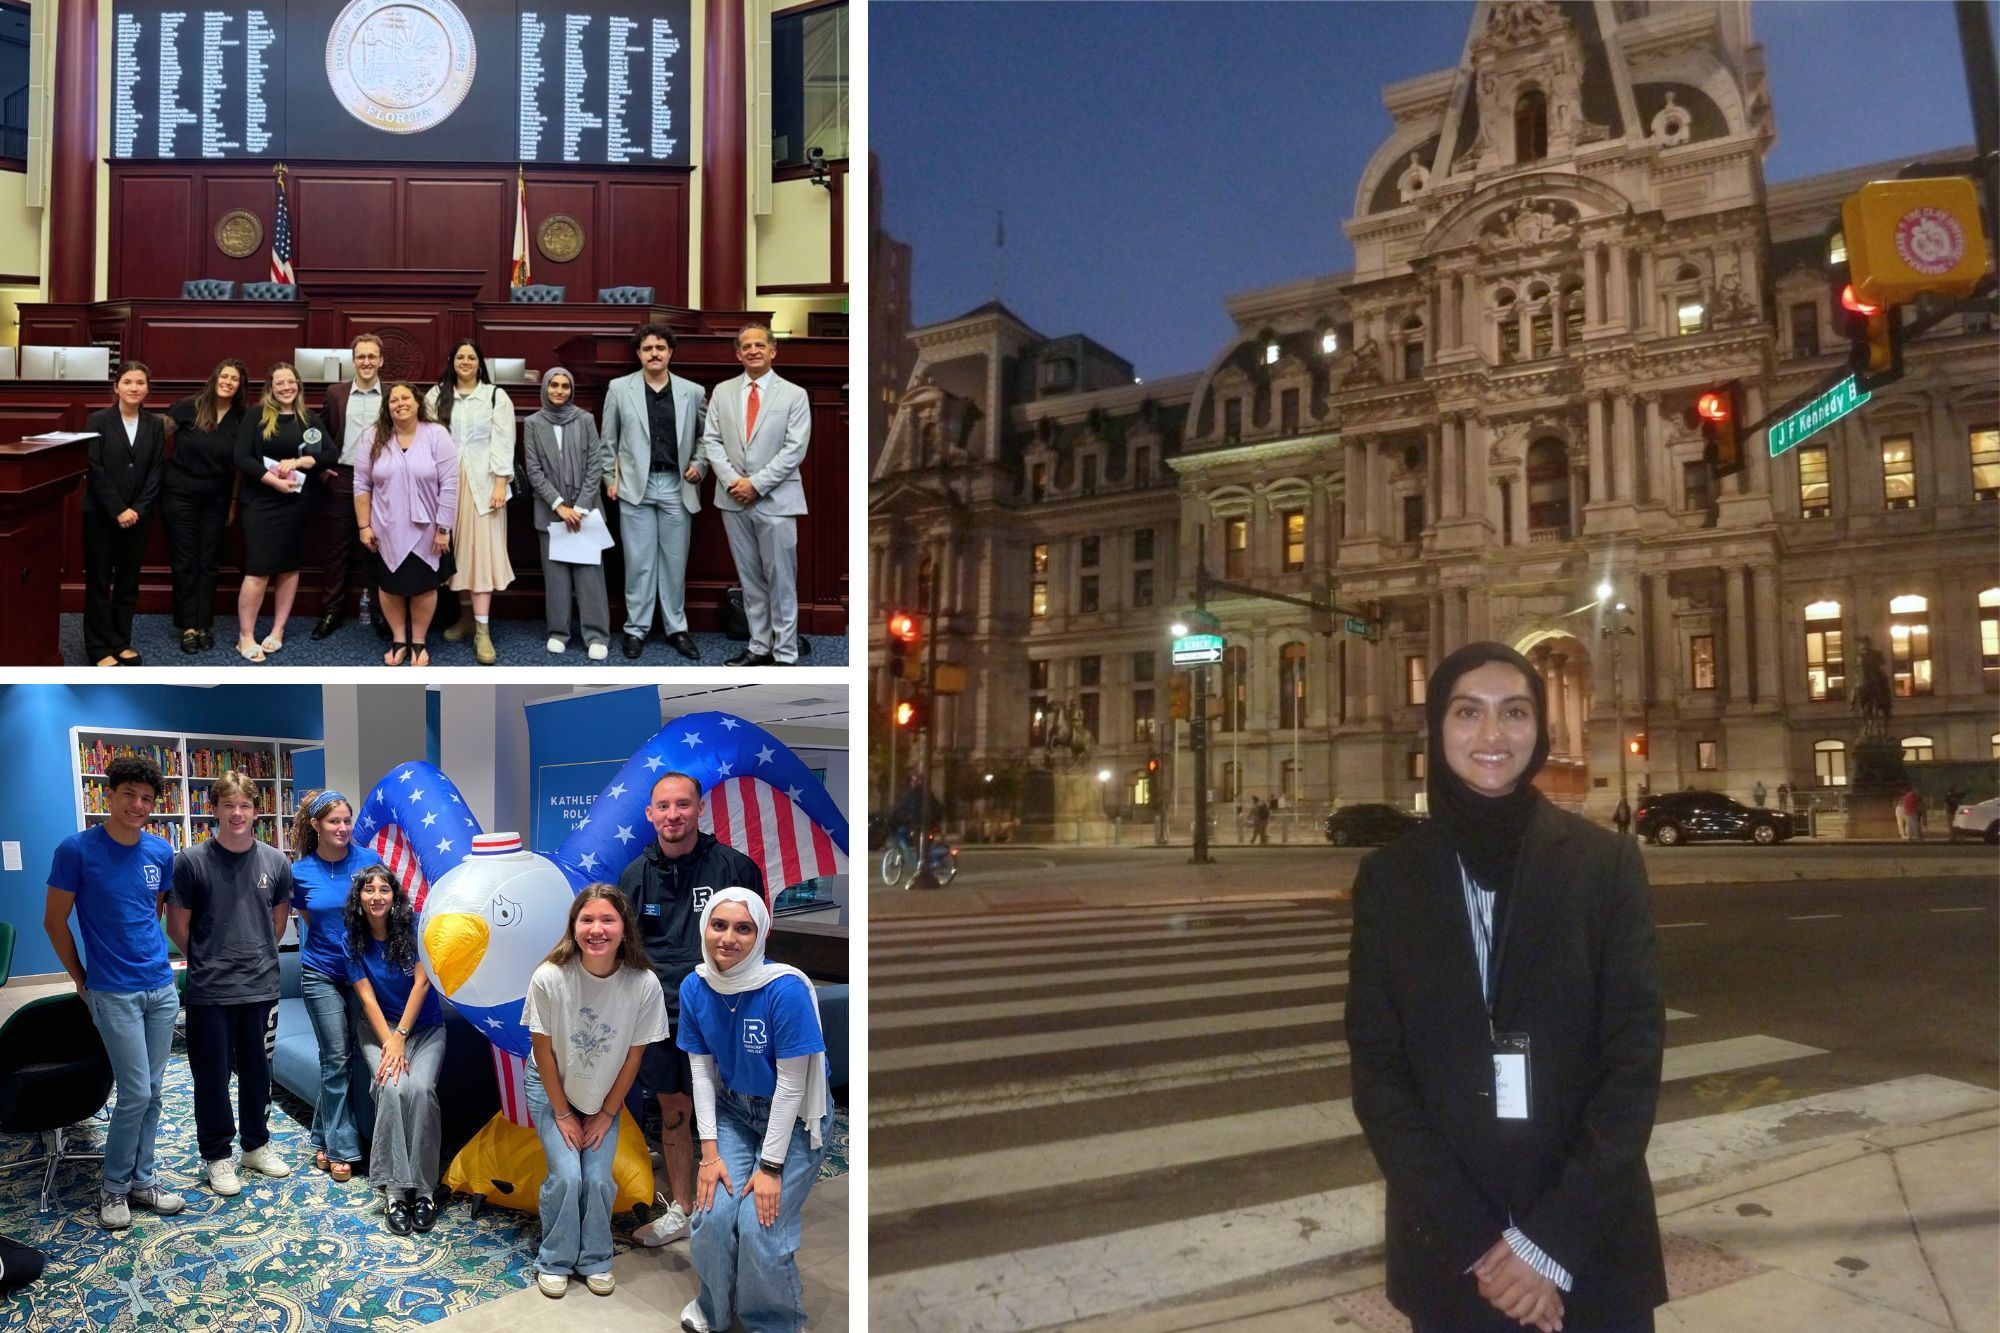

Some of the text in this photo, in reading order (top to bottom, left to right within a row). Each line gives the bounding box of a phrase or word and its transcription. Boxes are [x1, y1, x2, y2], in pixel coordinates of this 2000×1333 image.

[366, 104, 433, 124] FLORIDA
[1778, 427, 1785, 446] J
[1788, 420, 1795, 441] F
[1799, 393, 1844, 433] Kennedy
[143, 864, 161, 884] R
[743, 1018, 767, 1044] R
